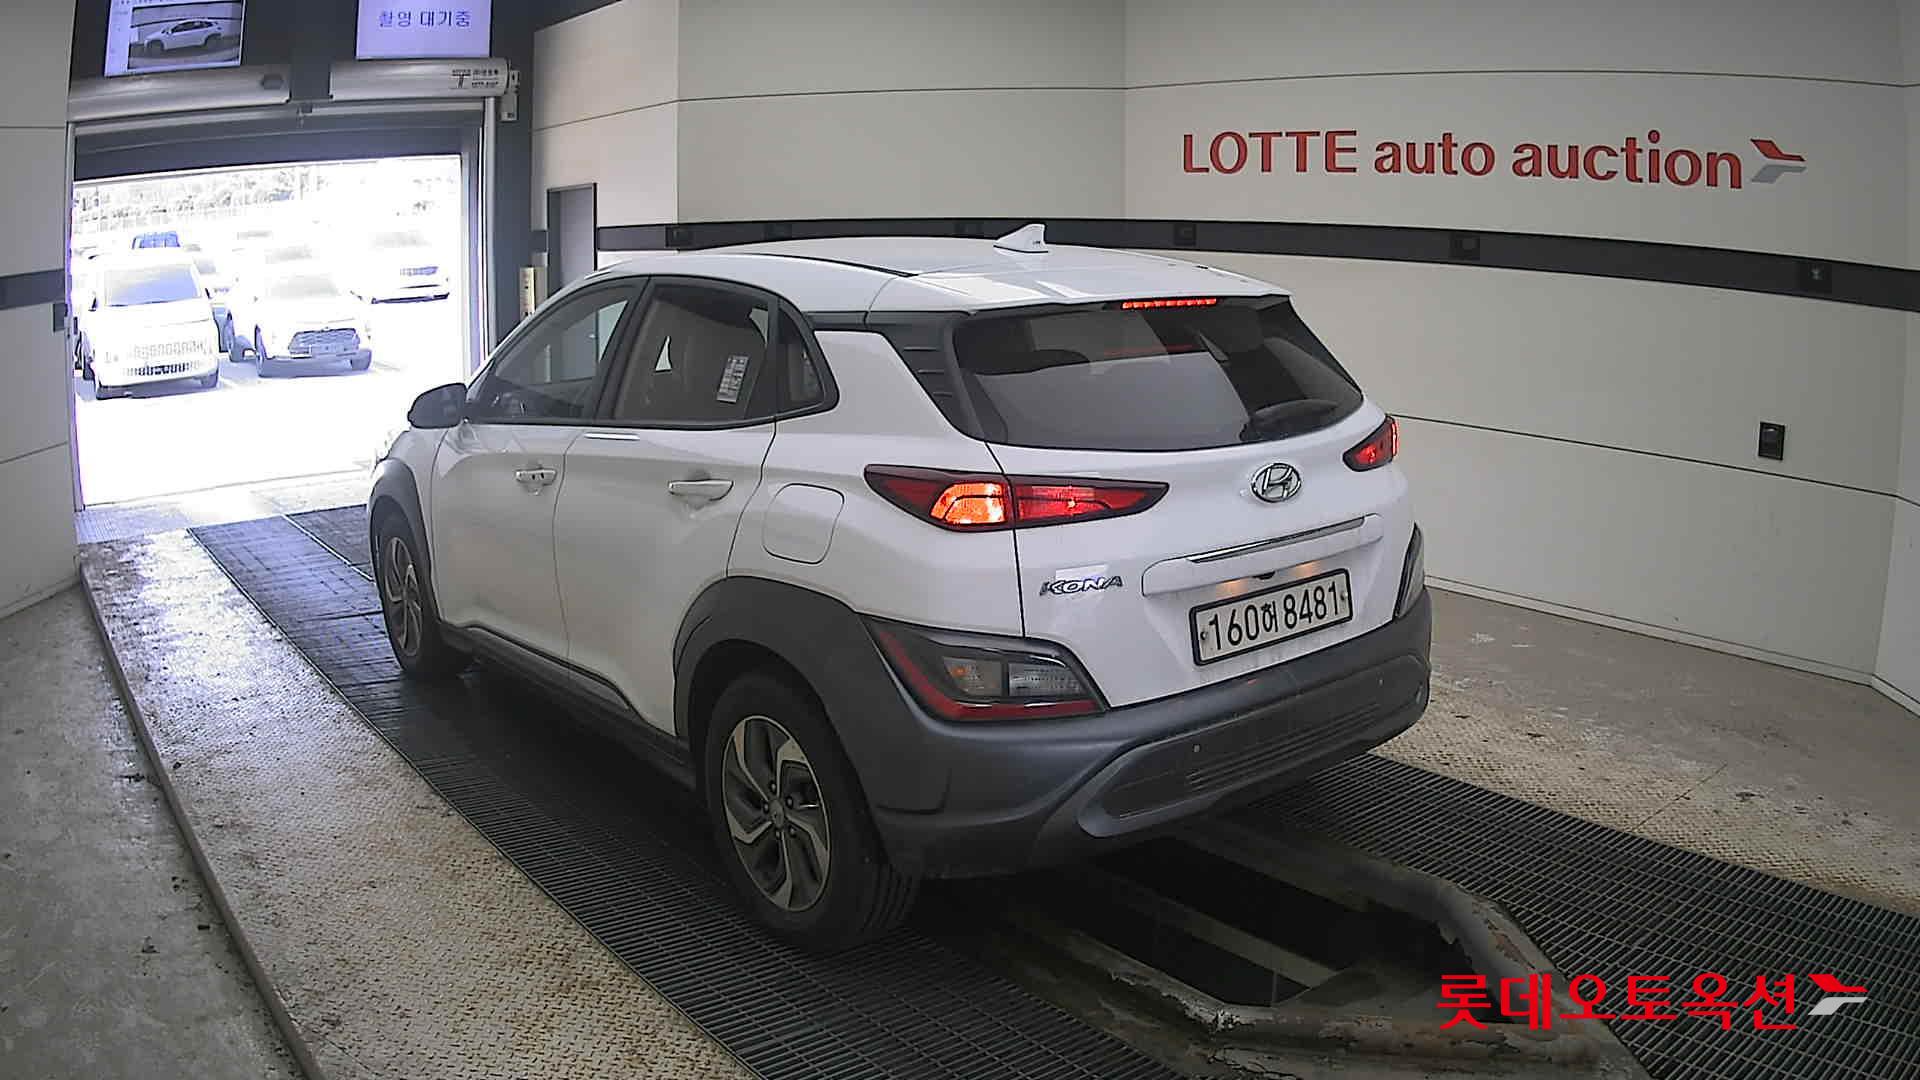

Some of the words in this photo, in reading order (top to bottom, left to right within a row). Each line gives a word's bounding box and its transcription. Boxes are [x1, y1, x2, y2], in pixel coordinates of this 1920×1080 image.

[419, 10, 471, 28] 대기중
[1183, 130, 1358, 174] LOTTE
[1374, 131, 1496, 177] auto
[1512, 130, 1743, 189] auction
[1040, 575, 1124, 597] KONA
